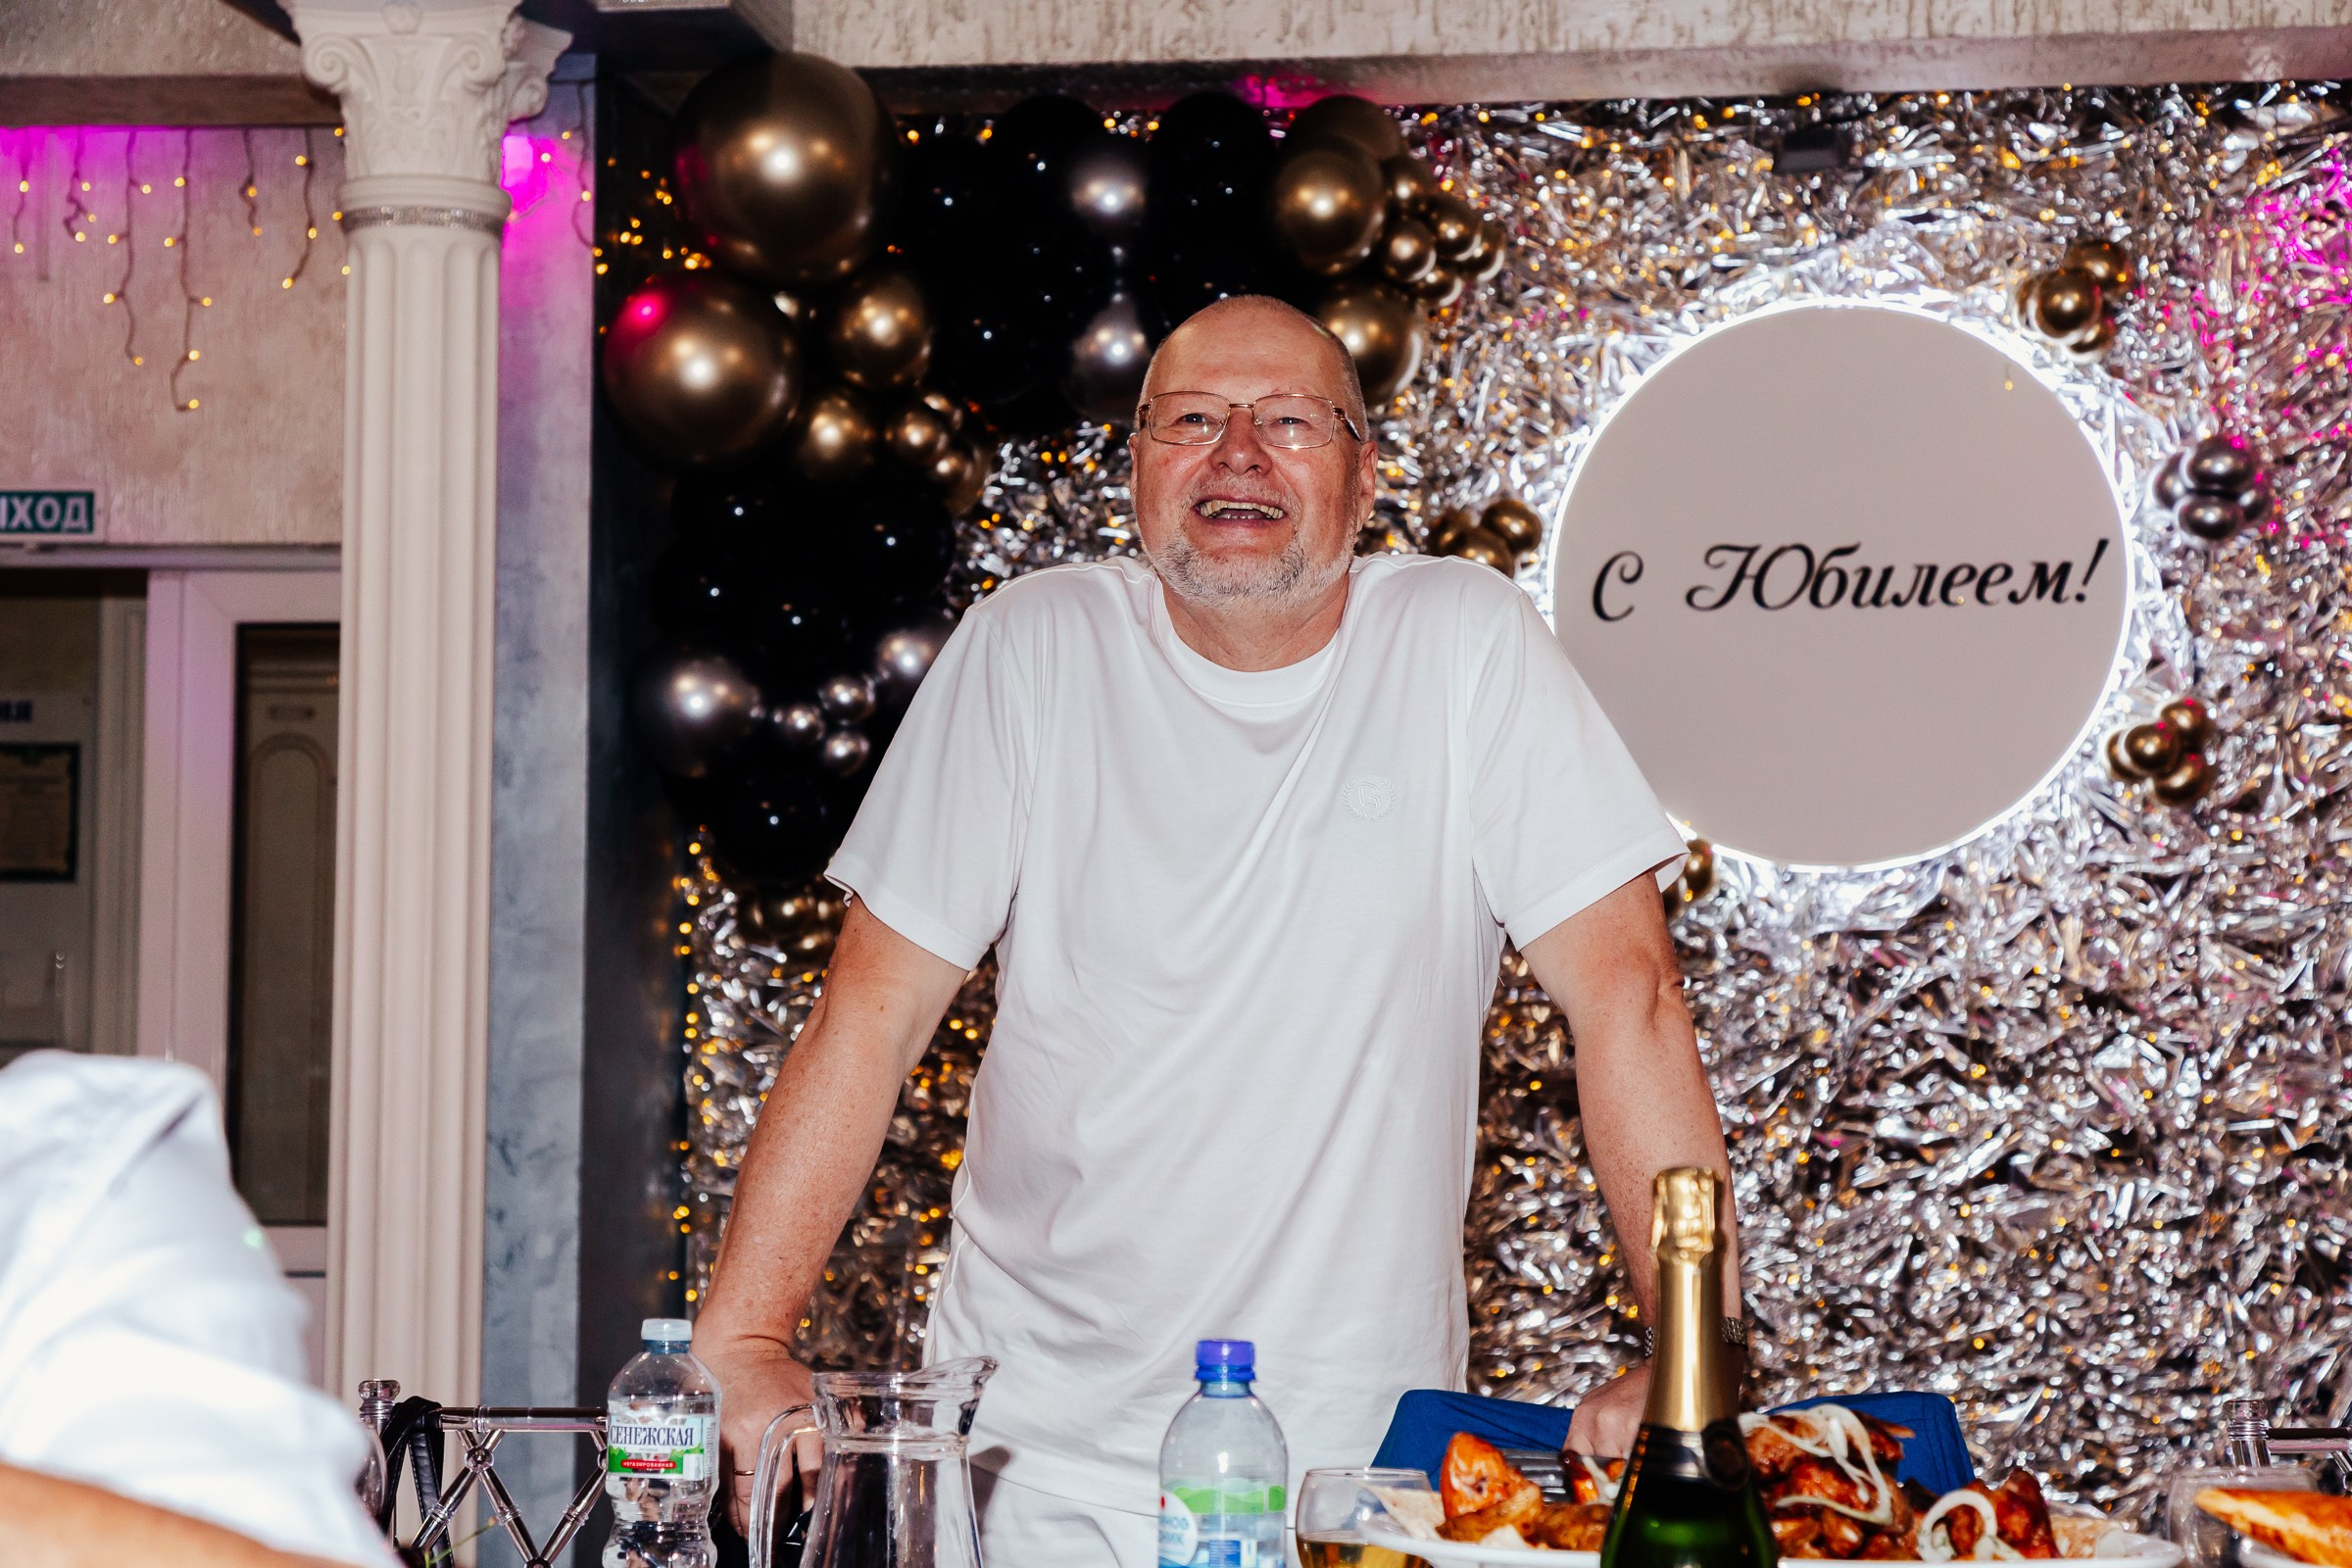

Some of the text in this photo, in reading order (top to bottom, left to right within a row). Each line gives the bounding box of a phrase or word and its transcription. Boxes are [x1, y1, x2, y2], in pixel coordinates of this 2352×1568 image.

[1592, 538, 2109, 622] С Юбилеем!
[610, 1426, 694, 1446] СЕНЕЖСКАЯ
